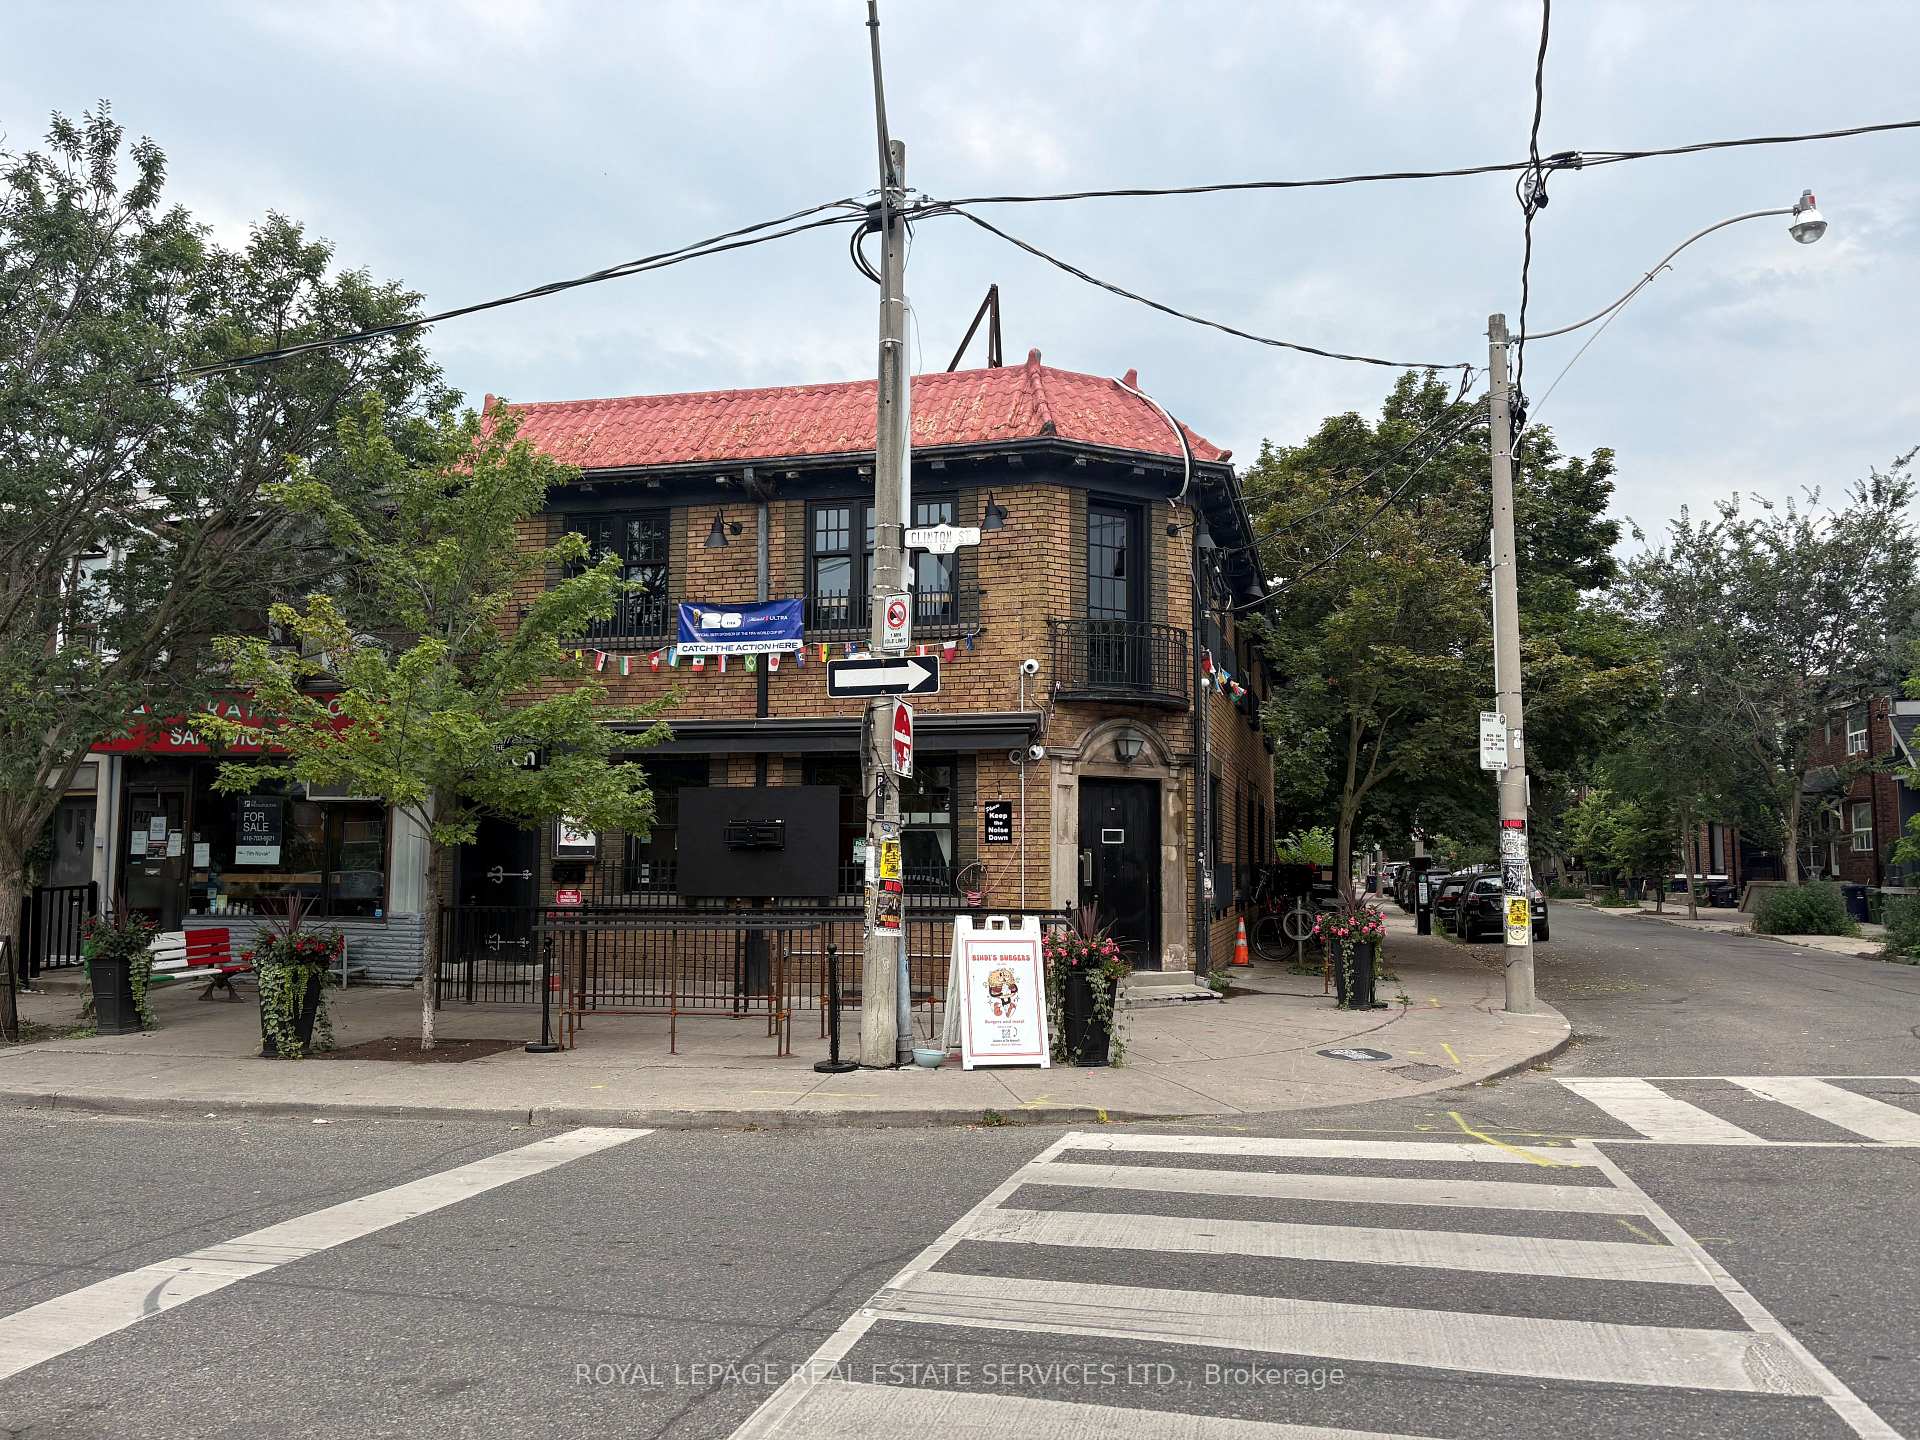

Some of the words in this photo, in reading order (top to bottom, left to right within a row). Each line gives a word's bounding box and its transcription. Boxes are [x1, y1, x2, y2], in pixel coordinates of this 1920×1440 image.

[911, 531, 953, 544] CLINTON
[939, 543, 947, 551] 12
[681, 645, 714, 653] CATCH
[715, 644, 734, 652] THE
[735, 643, 772, 652] ACTION
[772, 641, 799, 650] HERE
[243, 811, 265, 822] FOR
[989, 812, 1008, 820] Keep
[243, 822, 270, 832] SALE
[999, 954, 1031, 962] BURGERS
